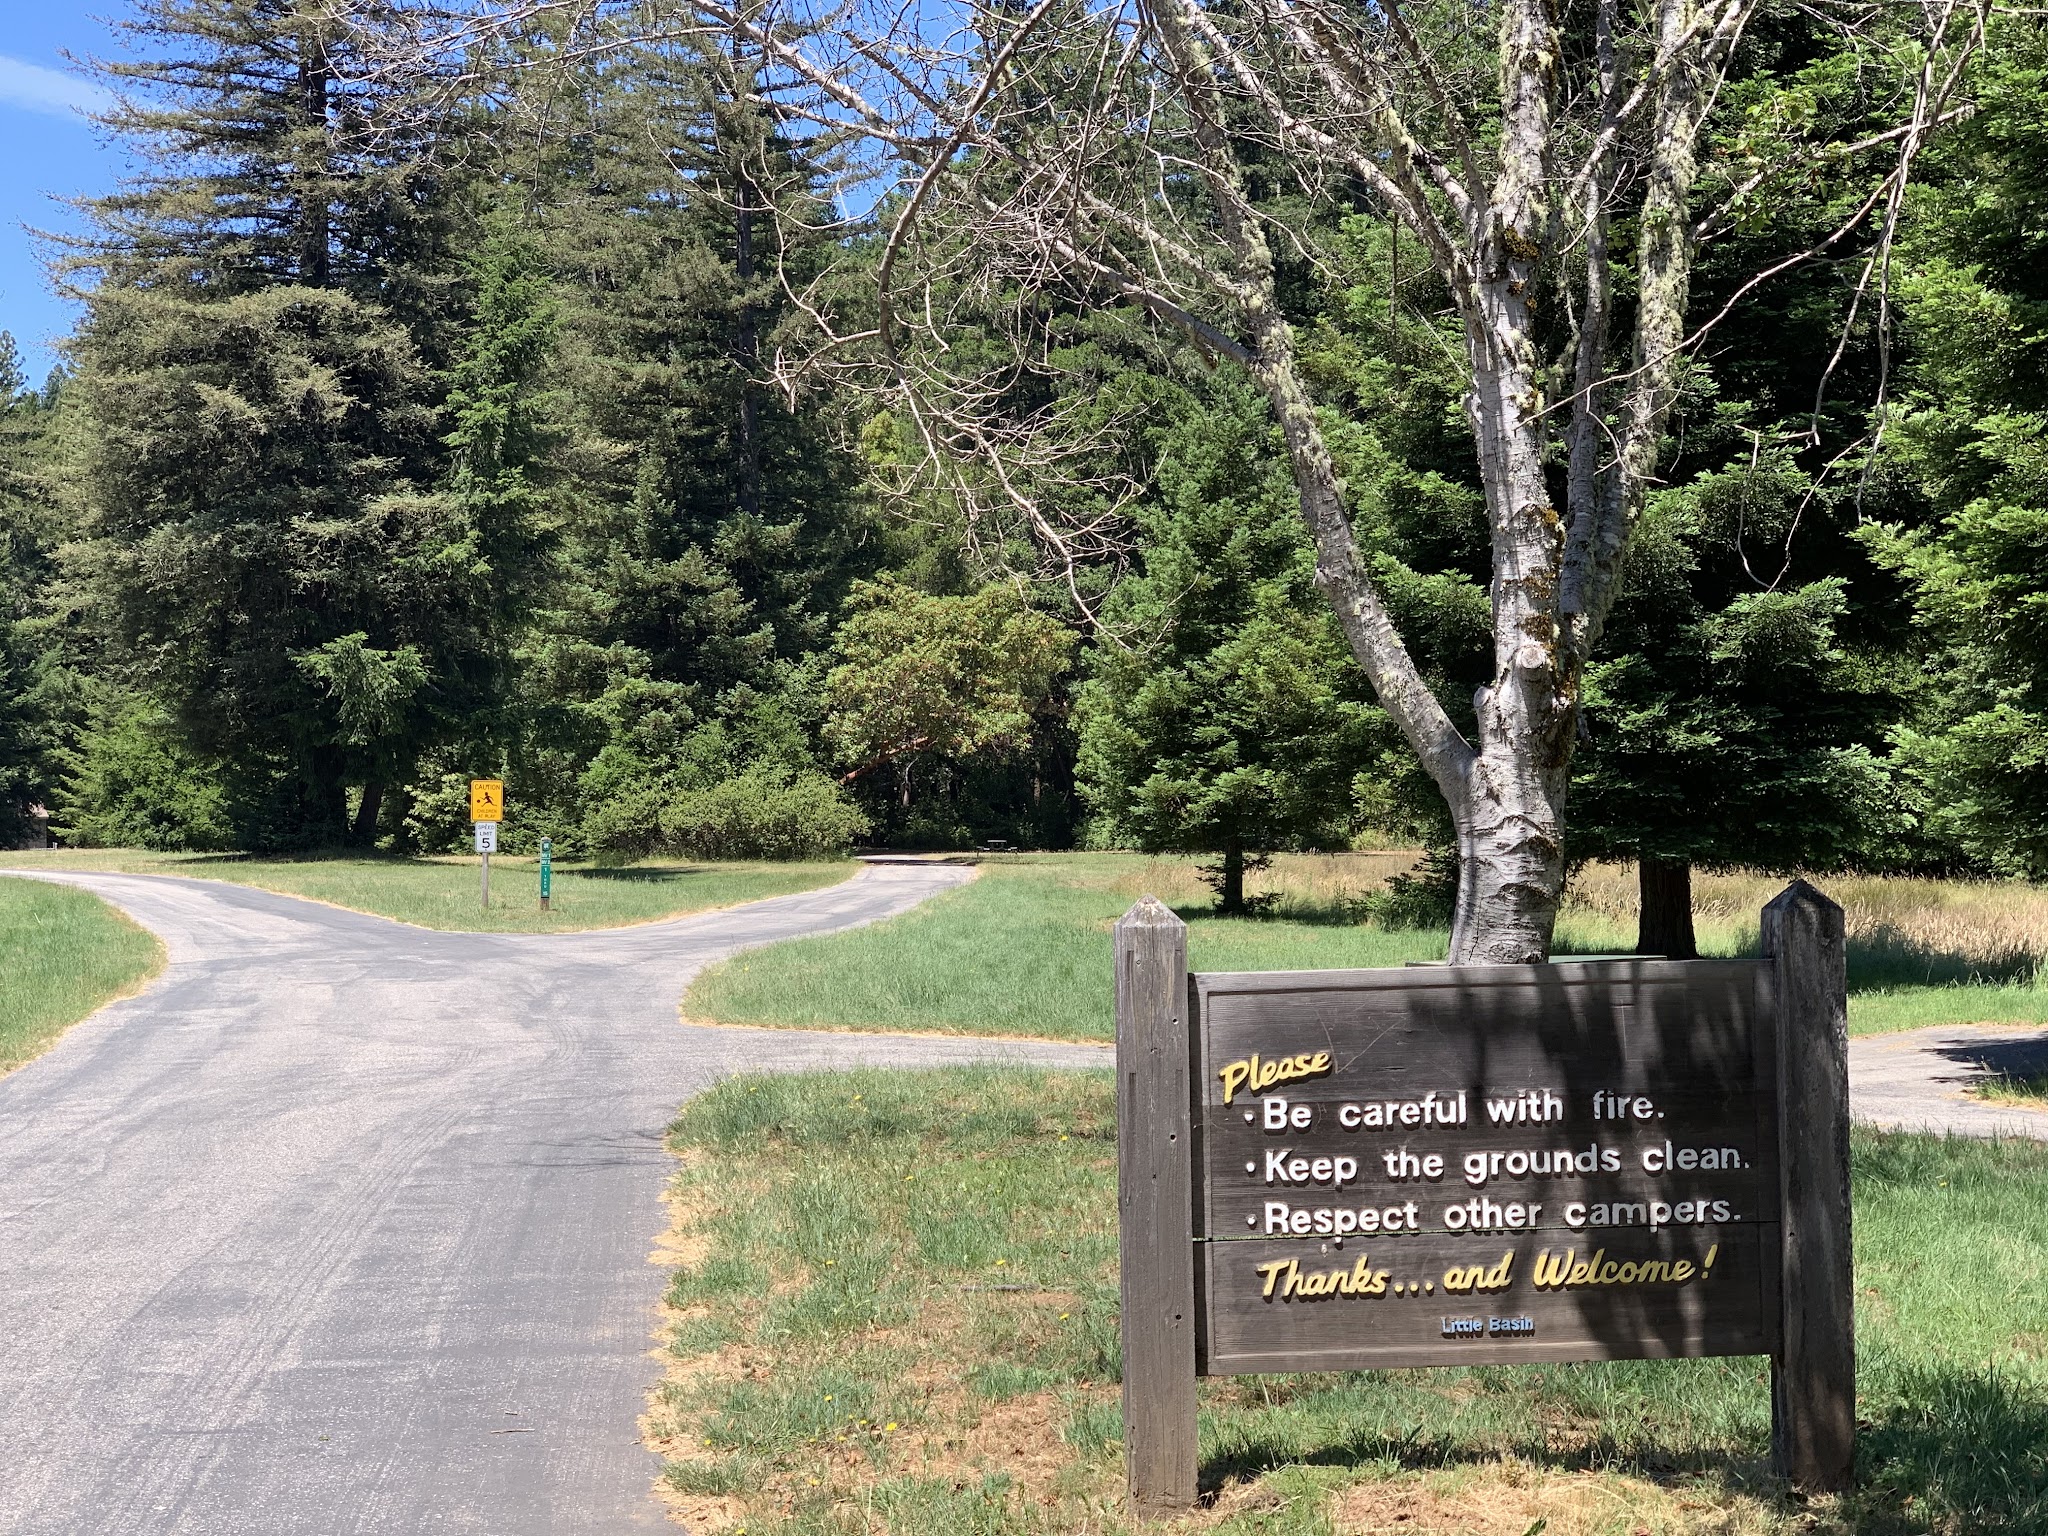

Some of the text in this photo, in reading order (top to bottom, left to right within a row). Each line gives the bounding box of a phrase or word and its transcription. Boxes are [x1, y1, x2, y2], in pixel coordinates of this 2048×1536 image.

[482, 838, 490, 848] 5
[1219, 1051, 1332, 1105] Please
[1264, 1088, 1666, 1131] Be careful with fire.
[1265, 1140, 1751, 1184] Keep the grounds clean.
[1264, 1197, 1742, 1244] Respect other campers.
[1442, 1249, 1515, 1290] and
[1441, 1315, 1535, 1335] Little Basin
